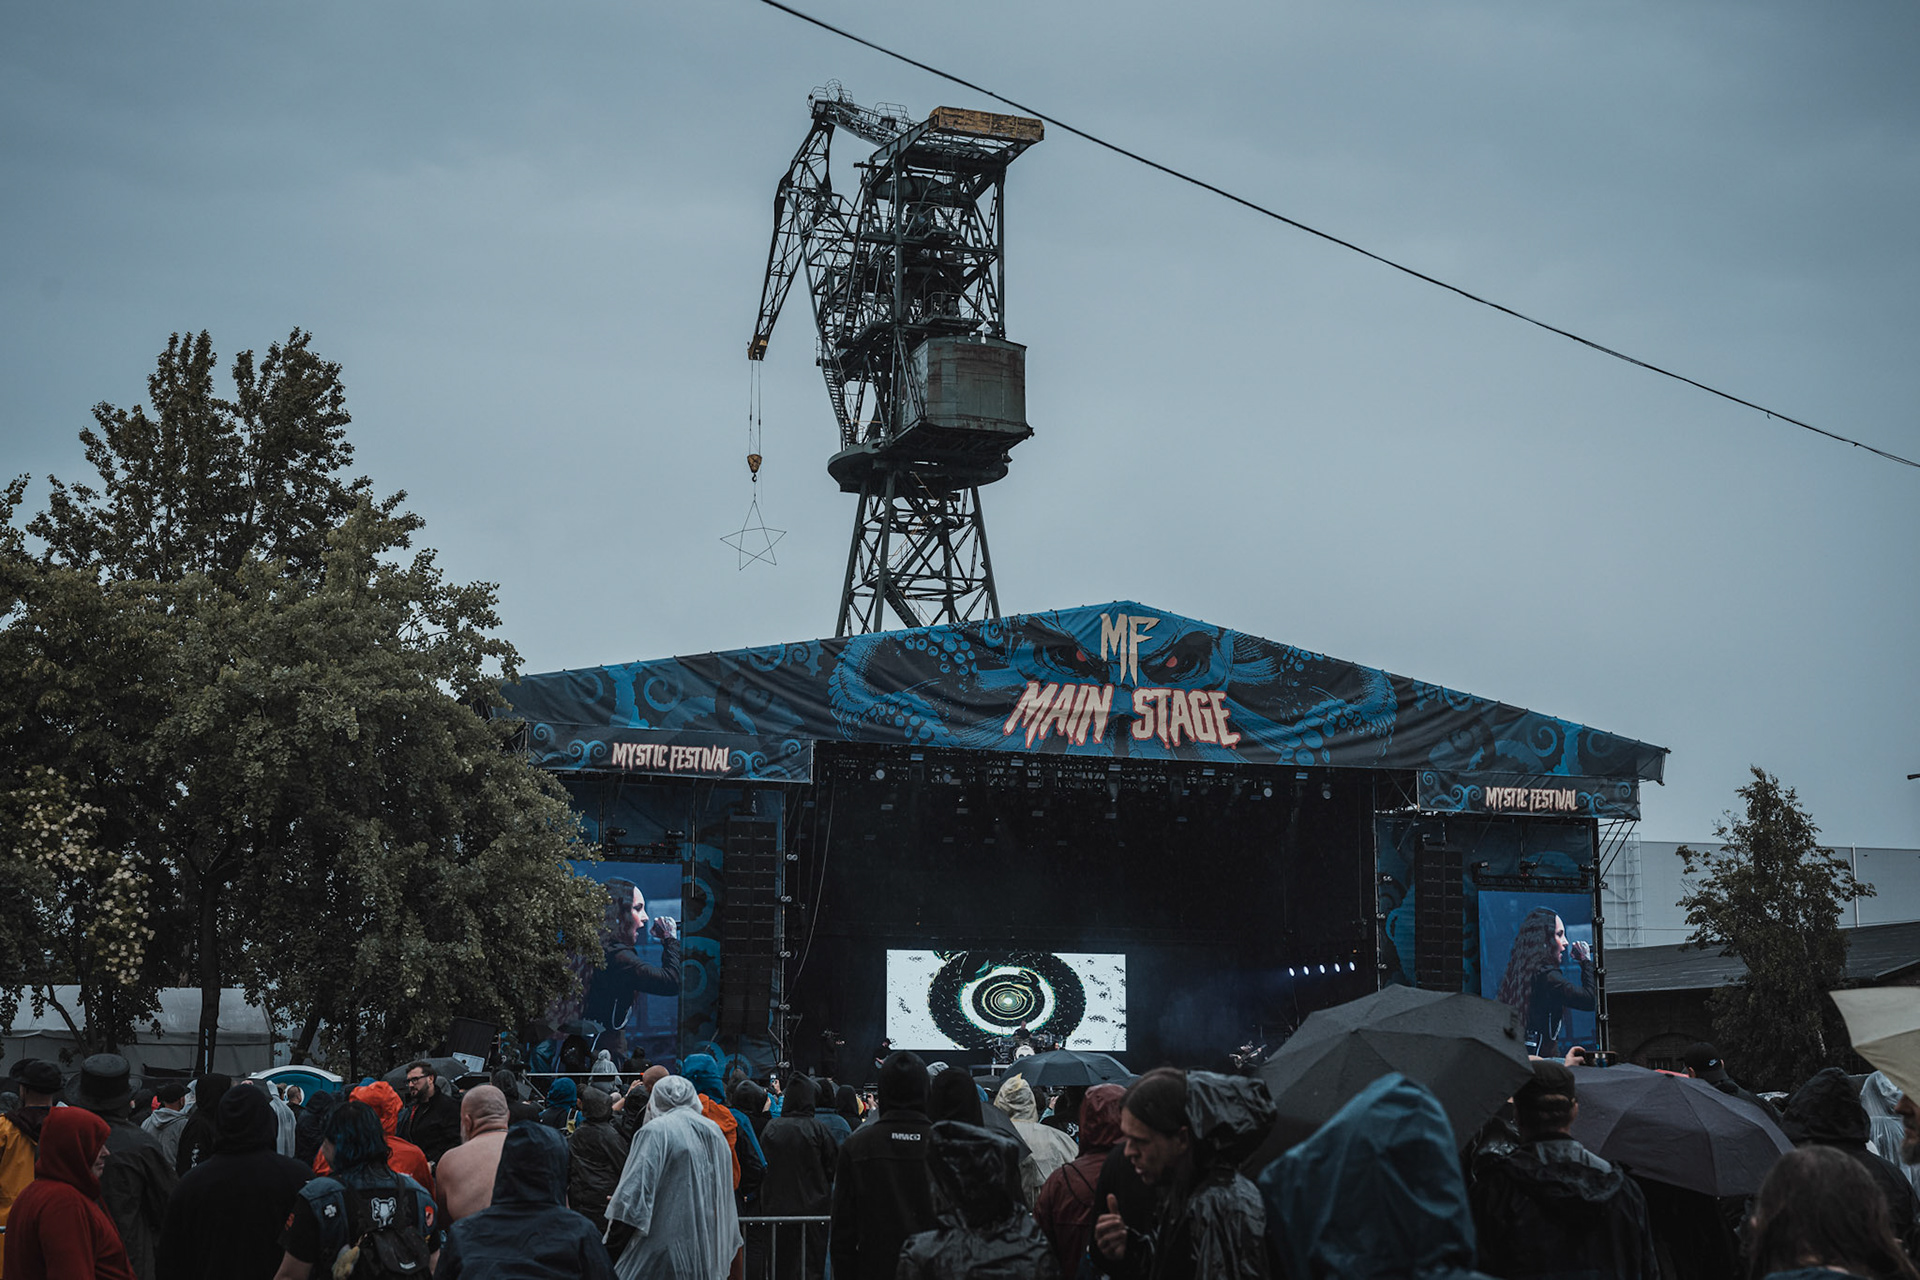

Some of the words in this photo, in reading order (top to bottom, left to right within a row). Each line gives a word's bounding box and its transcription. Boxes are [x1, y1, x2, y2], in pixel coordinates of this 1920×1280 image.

[1100, 613, 1161, 686] MF
[1003, 681, 1114, 748] MAIN
[1131, 687, 1241, 749] STAGE
[612, 743, 668, 770] MYSTIC
[669, 745, 731, 772] FESTIVAL
[1485, 786, 1528, 811] MYSTIC
[1529, 788, 1579, 813] FESTIVAL
